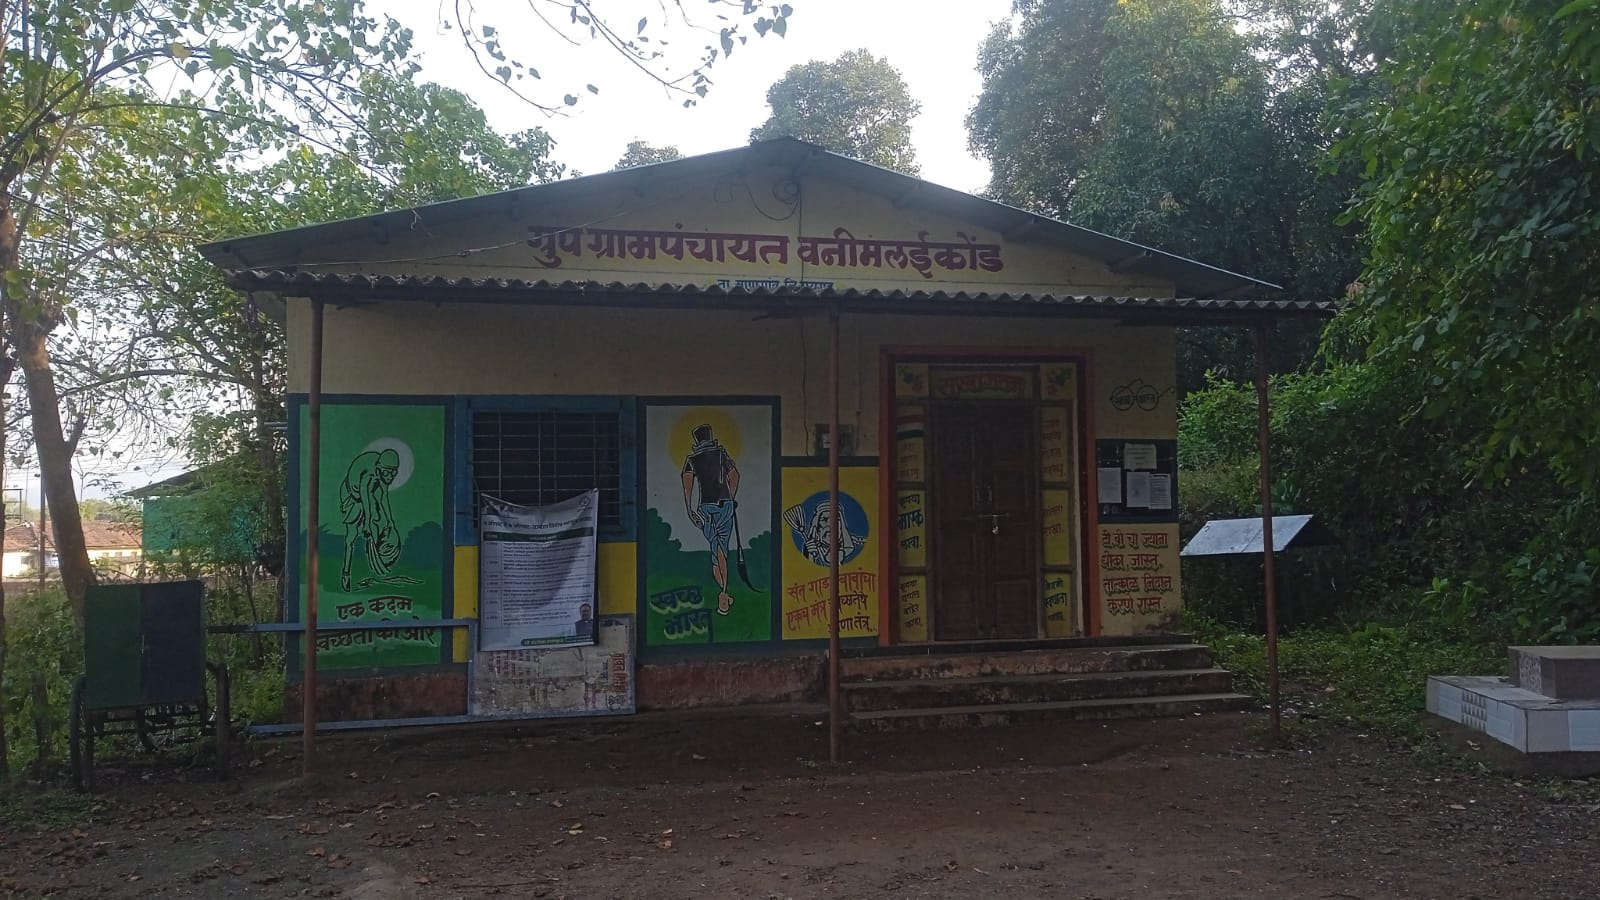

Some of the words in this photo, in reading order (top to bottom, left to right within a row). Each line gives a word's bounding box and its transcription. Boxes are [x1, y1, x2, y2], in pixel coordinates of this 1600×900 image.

[527, 226, 581, 268] ग्रुप
[586, 223, 788, 264] ग्रामपंचायत
[896, 509, 924, 530] मास्क
[787, 581, 807, 604] संत
[1142, 572, 1173, 593] निदान
[336, 601, 366, 620] एक
[367, 596, 413, 614] कदम
[786, 606, 811, 631] एकच
[810, 600, 828, 623] मंत्र
[664, 608, 713, 641] भारत
